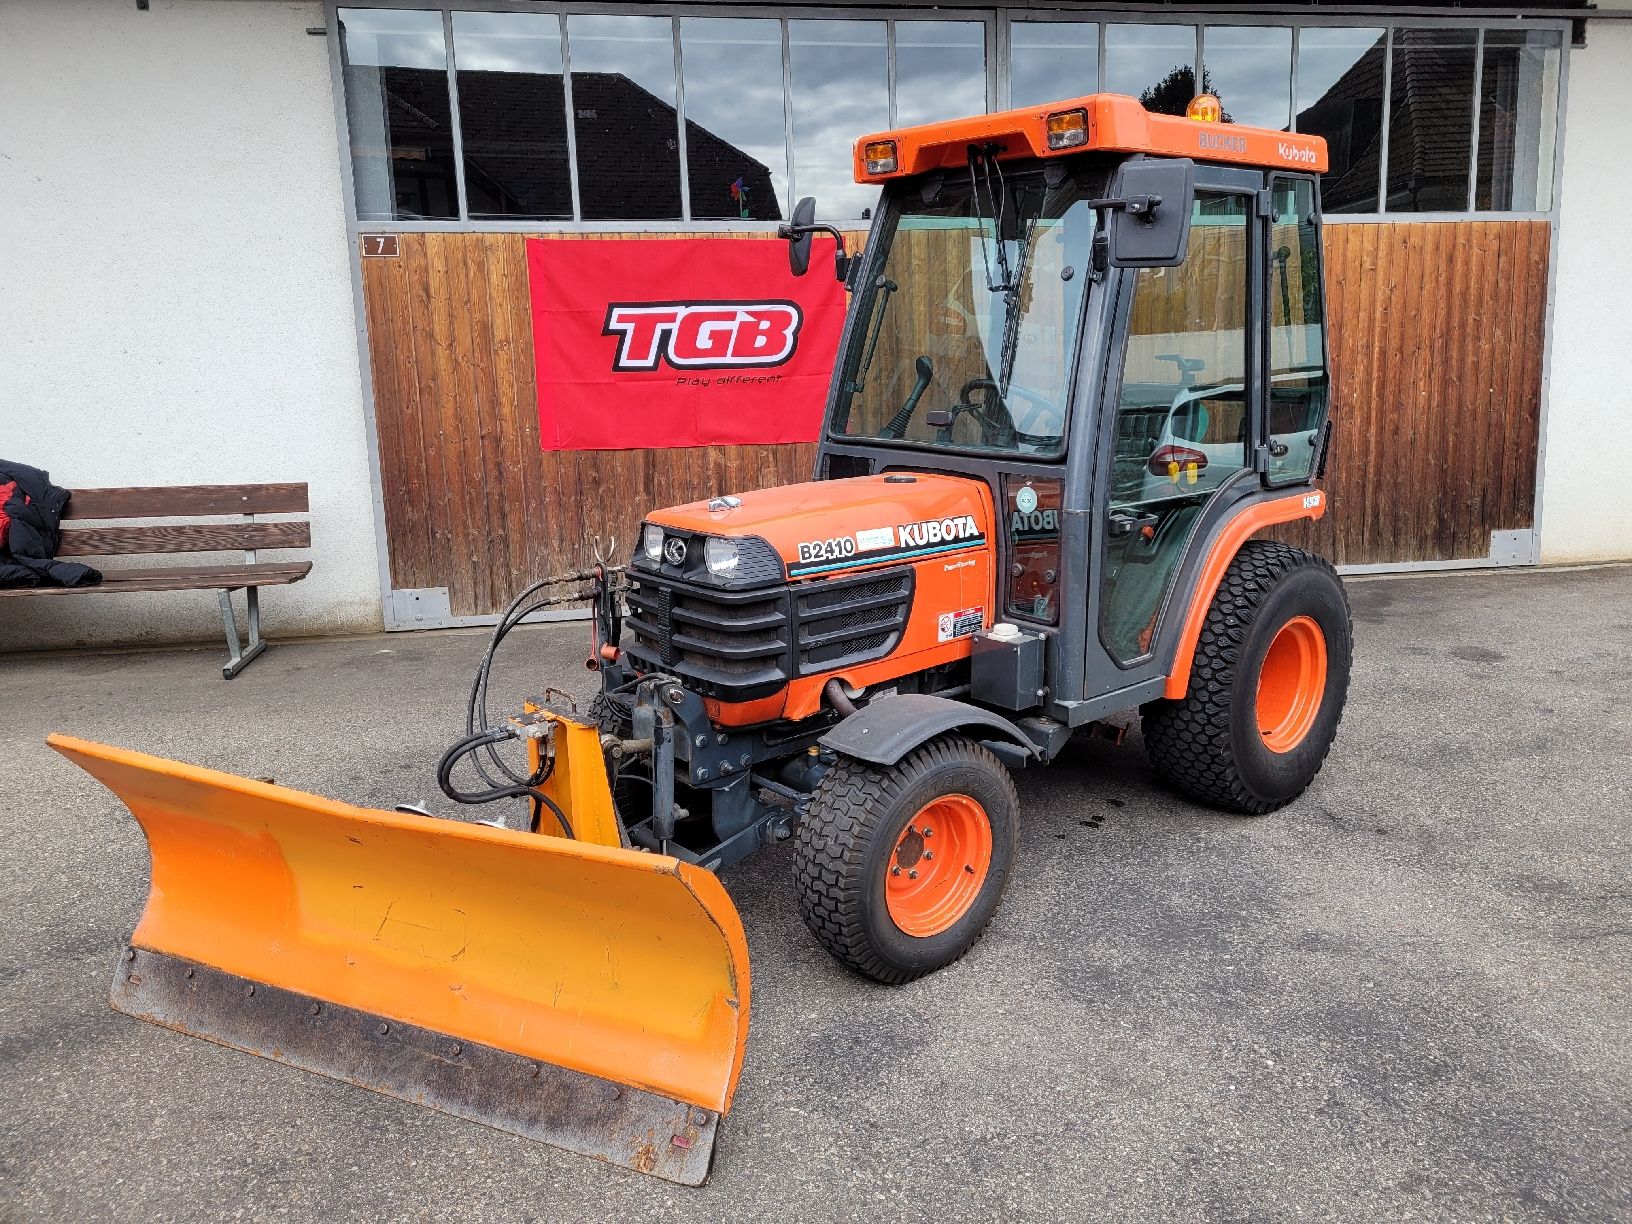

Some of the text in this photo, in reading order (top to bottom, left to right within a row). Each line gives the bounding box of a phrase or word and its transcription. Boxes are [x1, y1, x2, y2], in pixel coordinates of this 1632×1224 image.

[1199, 130, 1247, 153] BUCHER
[1278, 142, 1317, 164] Kubota
[376, 238, 385, 254] 7
[602, 299, 803, 372] TGB
[676, 374, 783, 387] Play different
[799, 536, 855, 562] B2410
[898, 515, 980, 548] KUBOTA
